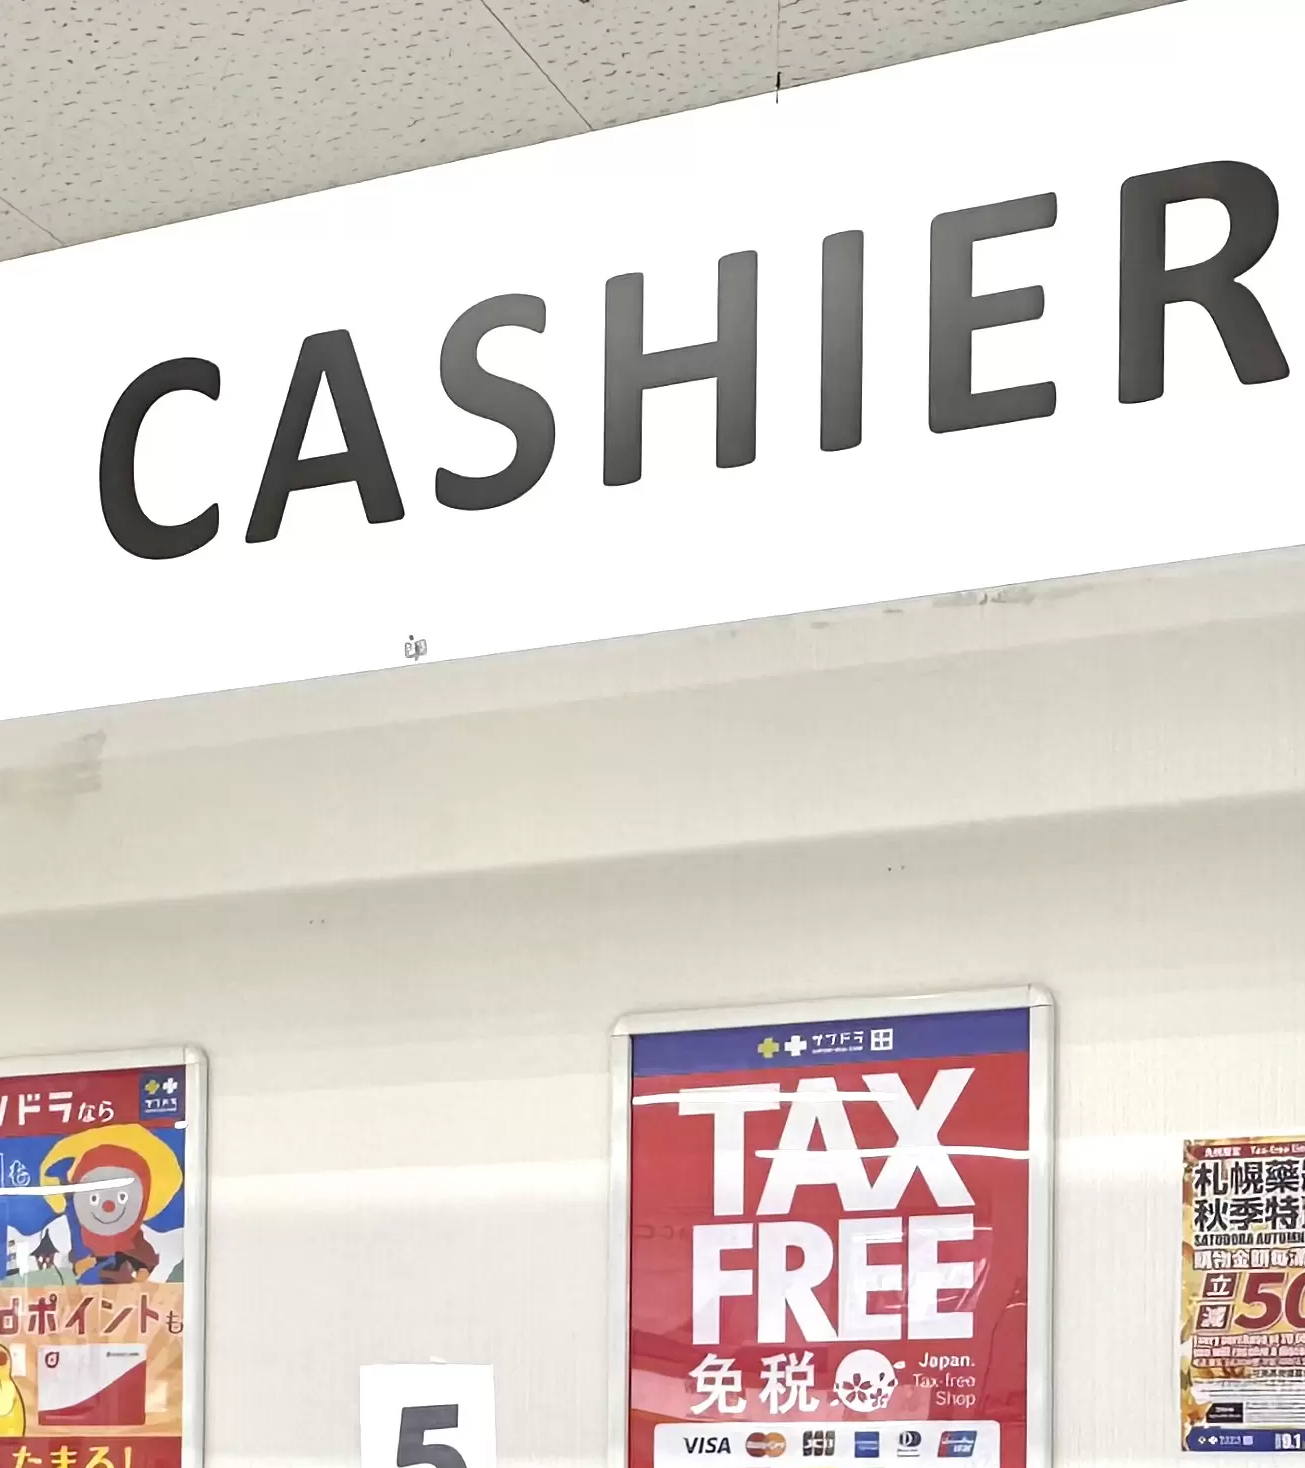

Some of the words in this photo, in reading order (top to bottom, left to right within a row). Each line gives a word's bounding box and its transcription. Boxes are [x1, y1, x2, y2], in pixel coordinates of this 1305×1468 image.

[98, 158, 1290, 560] CASHIER
[678, 1067, 976, 1216] TAX
[692, 1213, 975, 1344] FREE
[688, 1351, 820, 1415] 免税
[935, 1391, 976, 1409] Shop
[684, 1437, 731, 1454] VISA
